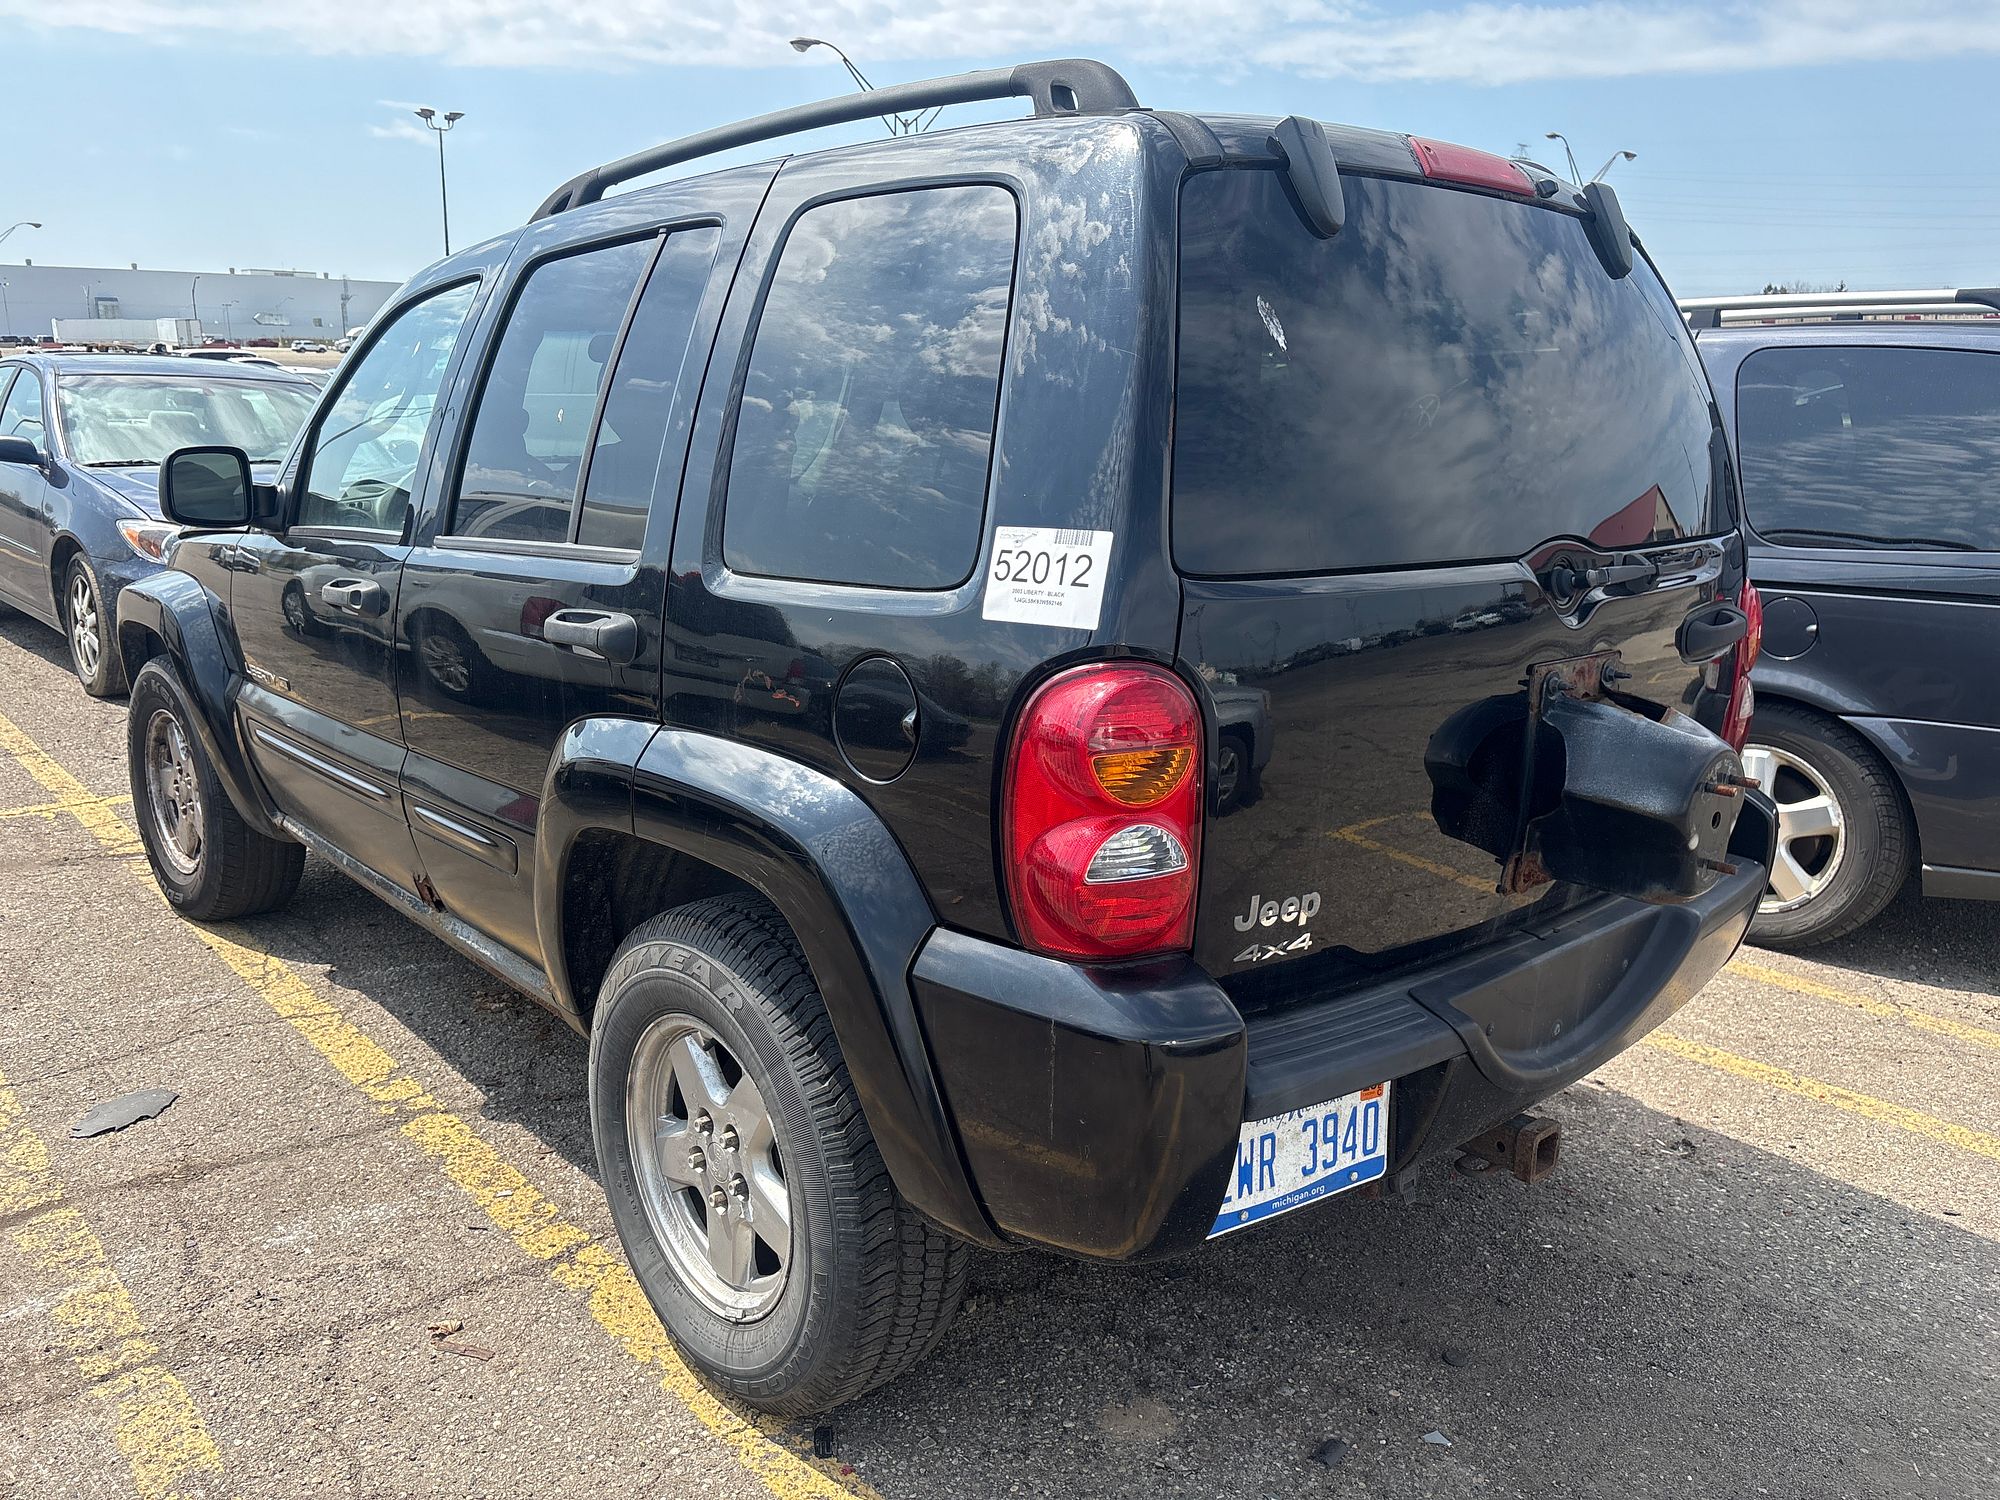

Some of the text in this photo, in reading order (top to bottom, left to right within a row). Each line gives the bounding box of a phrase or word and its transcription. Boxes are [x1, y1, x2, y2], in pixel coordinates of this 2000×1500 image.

[994, 549, 1093, 588] 52012
[1024, 589, 1044, 597] LIBERTY
[1047, 591, 1065, 599] BLACK
[1233, 891, 1321, 932] Jeep
[1223, 1100, 1380, 1204] WR 3940
[1271, 1185, 1325, 1210] michigan.org
